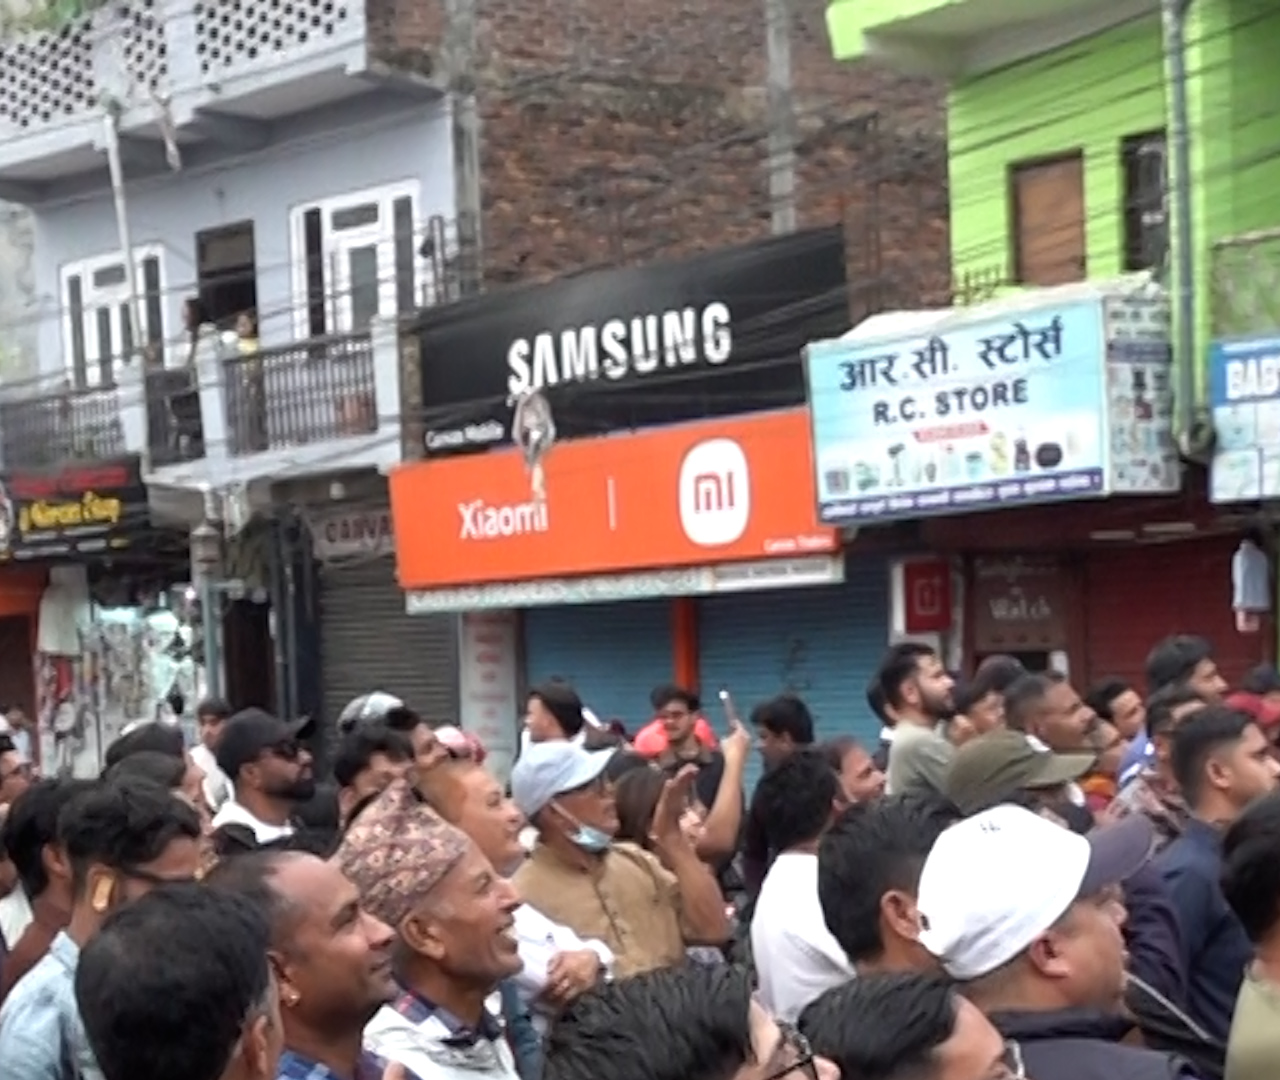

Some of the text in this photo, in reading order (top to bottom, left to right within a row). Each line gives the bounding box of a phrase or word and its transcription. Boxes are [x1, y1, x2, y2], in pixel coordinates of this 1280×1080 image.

[507, 302, 731, 394] SAMSUNG
[872, 379, 1028, 426] R.C. STORE
[458, 500, 548, 538] Xiaomi
